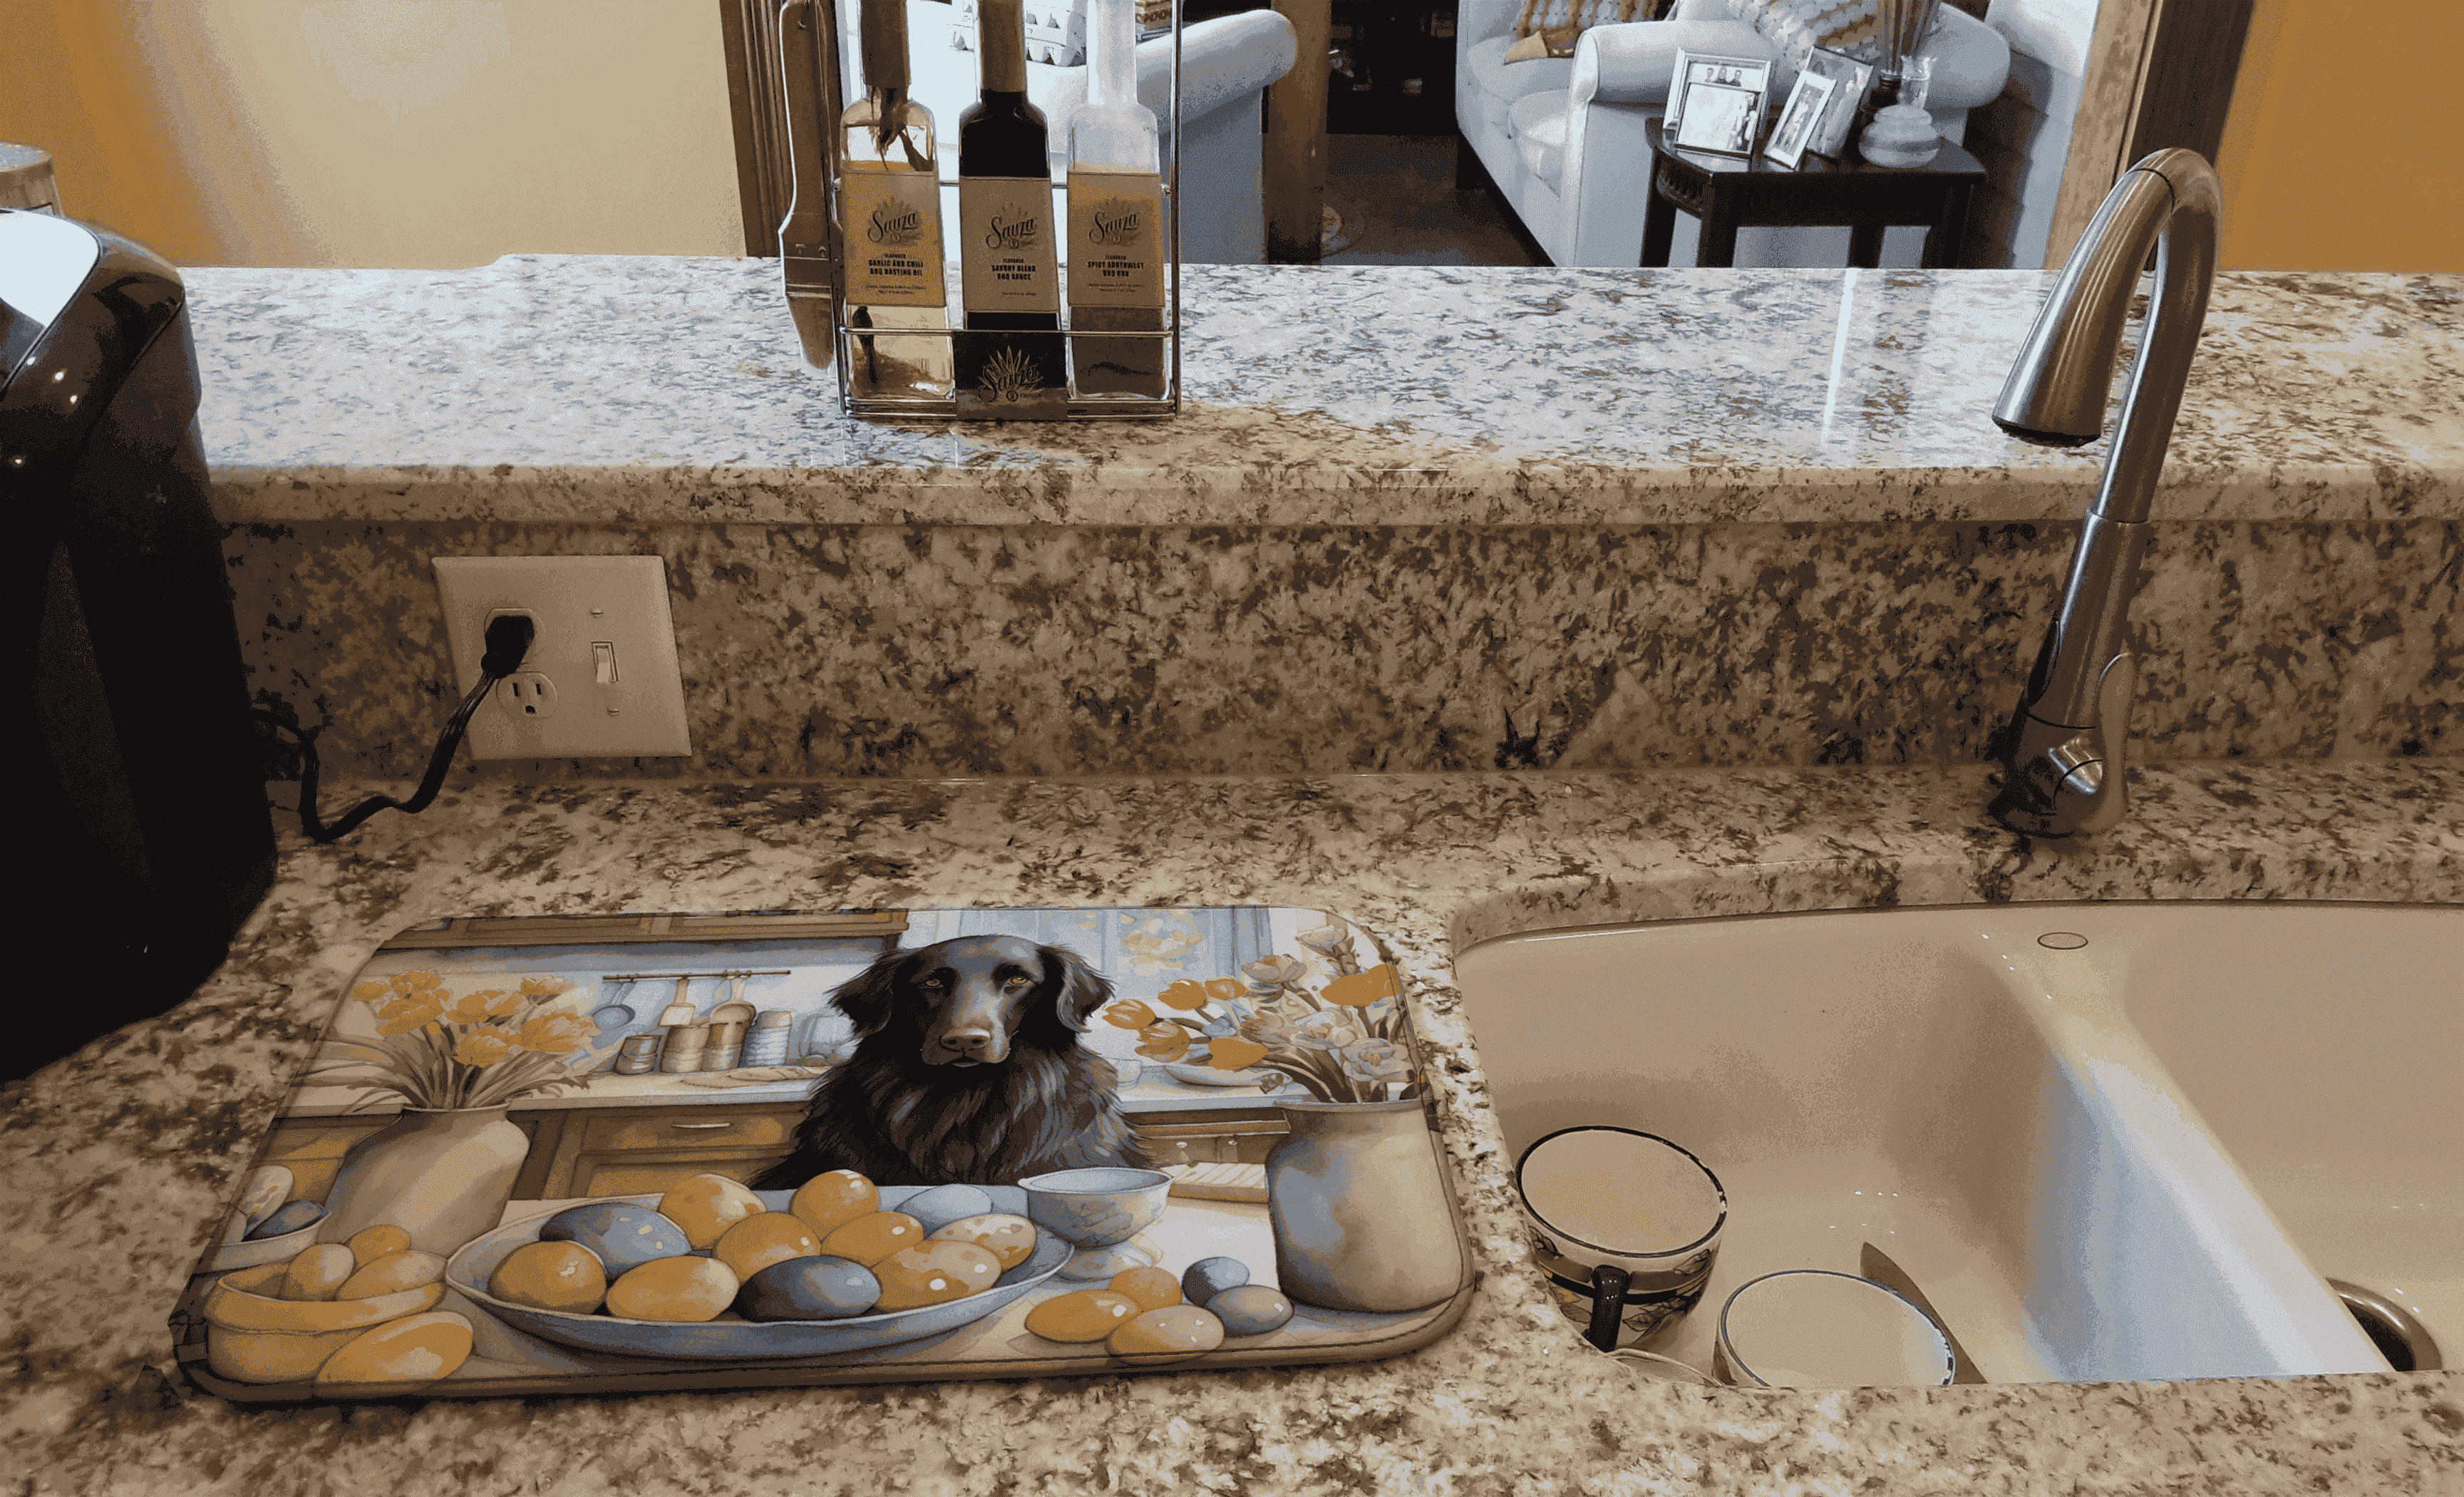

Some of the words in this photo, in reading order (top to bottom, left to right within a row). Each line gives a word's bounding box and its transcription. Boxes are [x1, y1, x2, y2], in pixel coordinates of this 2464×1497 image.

[867, 210, 919, 242] Sauza
[986, 216, 1037, 250] Sauza
[1089, 211, 1140, 245] Sauza
[978, 364, 1041, 403] Sauza
